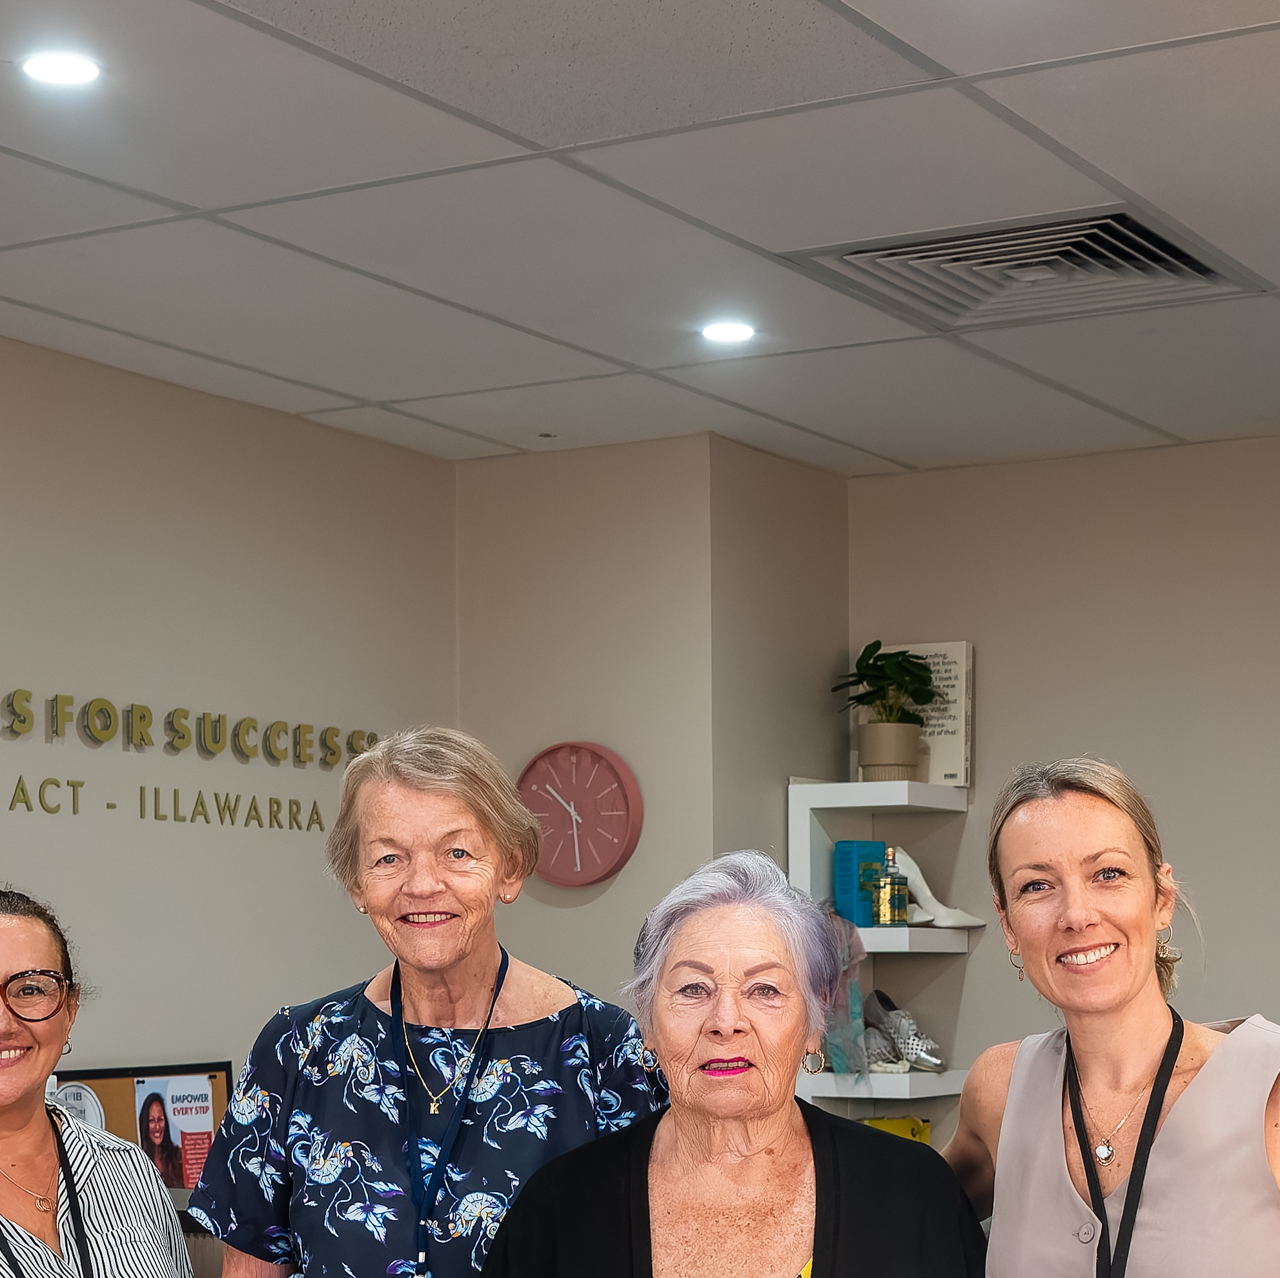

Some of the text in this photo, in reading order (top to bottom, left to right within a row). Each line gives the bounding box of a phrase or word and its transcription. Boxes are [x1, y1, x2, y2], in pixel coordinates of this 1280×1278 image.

[51, 694, 156, 747] FOR
[8, 774, 86, 815] ACT
[138, 785, 326, 833] ILLAWARRA
[172, 1094, 209, 1104] EMPOWER
[173, 1106, 209, 1116] EVERY STEP
